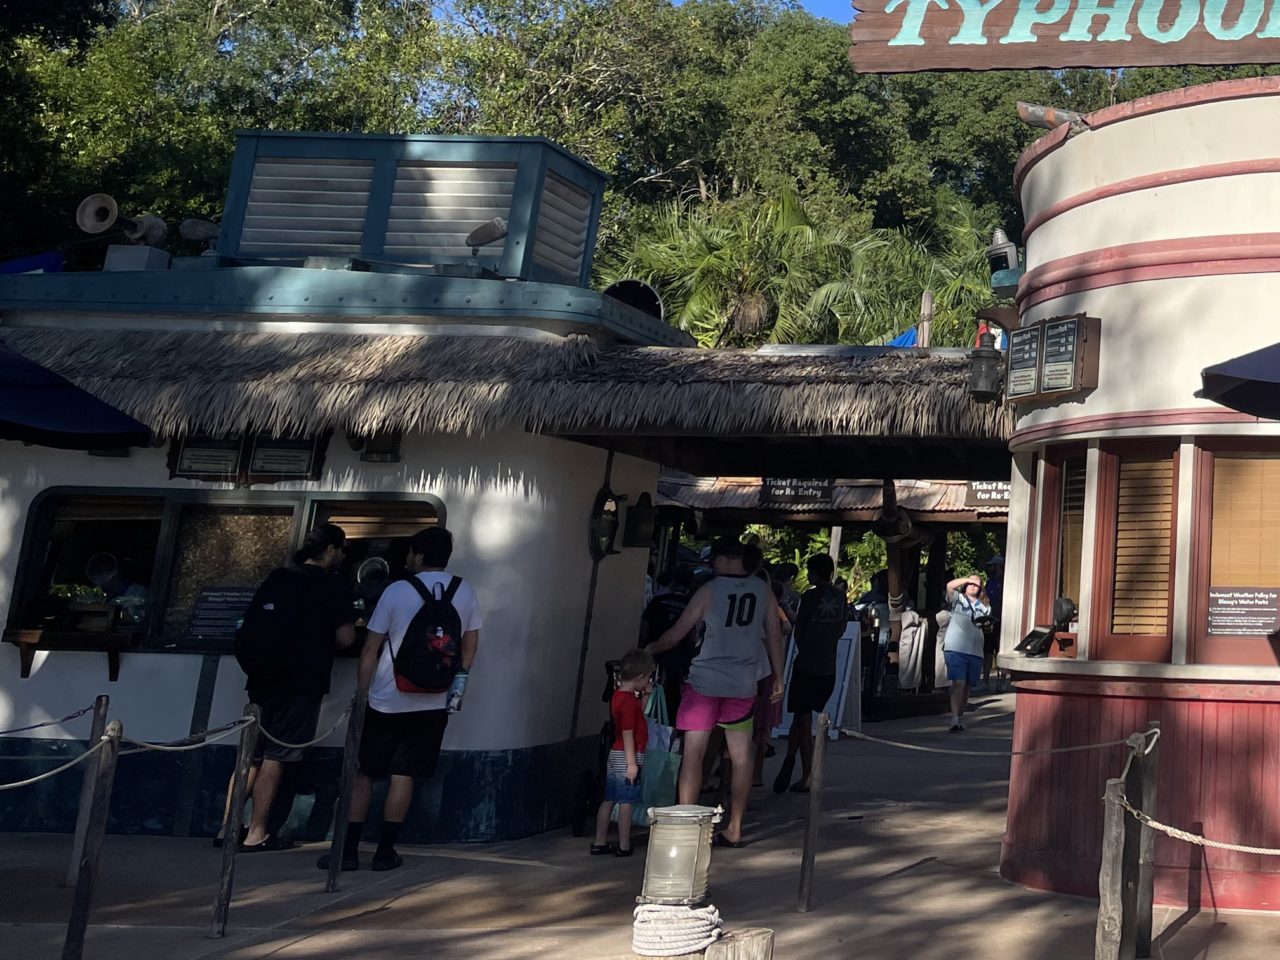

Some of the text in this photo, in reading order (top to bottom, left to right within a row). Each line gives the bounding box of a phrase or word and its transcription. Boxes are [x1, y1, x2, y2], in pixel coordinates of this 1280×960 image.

[766, 477, 829, 489] Ticket Required
[972, 481, 997, 490] Ticket
[771, 487, 784, 496] for
[976, 491, 990, 500] for
[724, 592, 757, 628] 10
